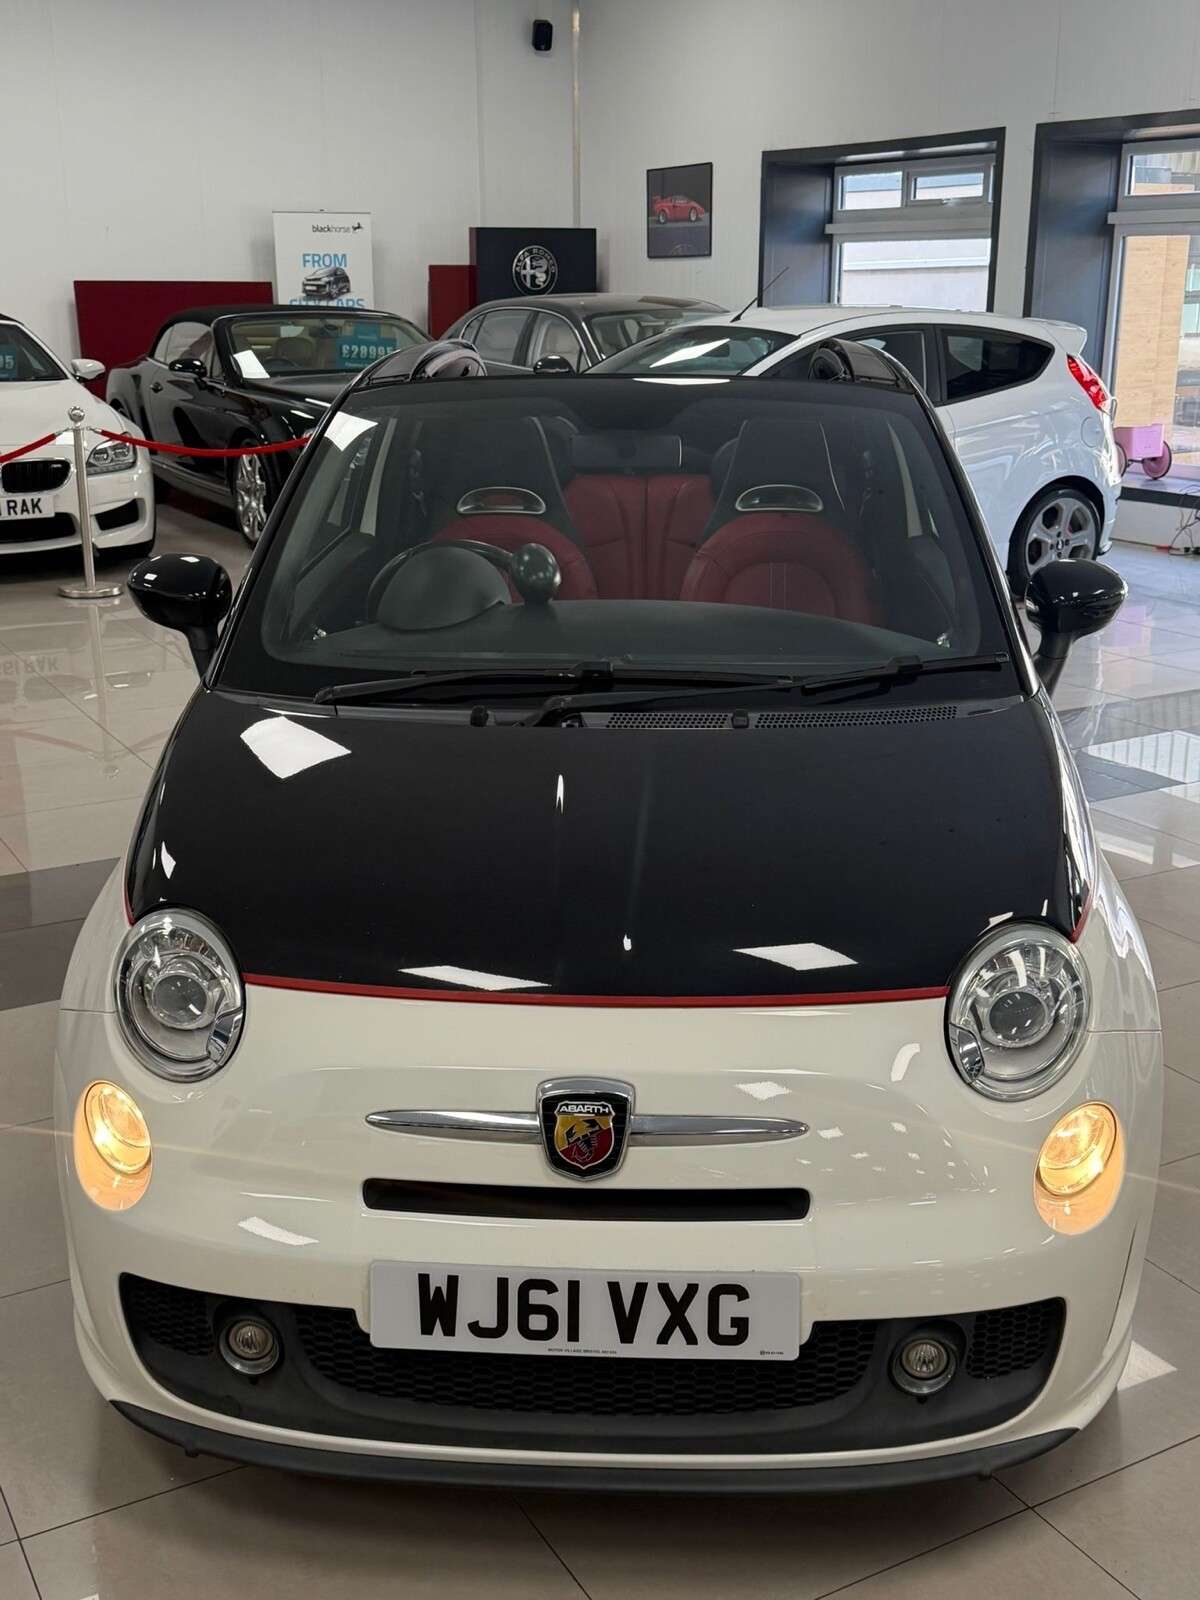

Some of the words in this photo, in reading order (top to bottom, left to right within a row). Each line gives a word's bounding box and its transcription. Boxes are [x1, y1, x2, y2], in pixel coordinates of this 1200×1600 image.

[312, 224, 350, 233] blackhorse
[302, 253, 347, 268] FROM
[6, 498, 43, 516] RAK
[560, 1105, 609, 1114] ABARTH
[417, 1273, 580, 1342] WJ61
[607, 1281, 750, 1346] VXG
